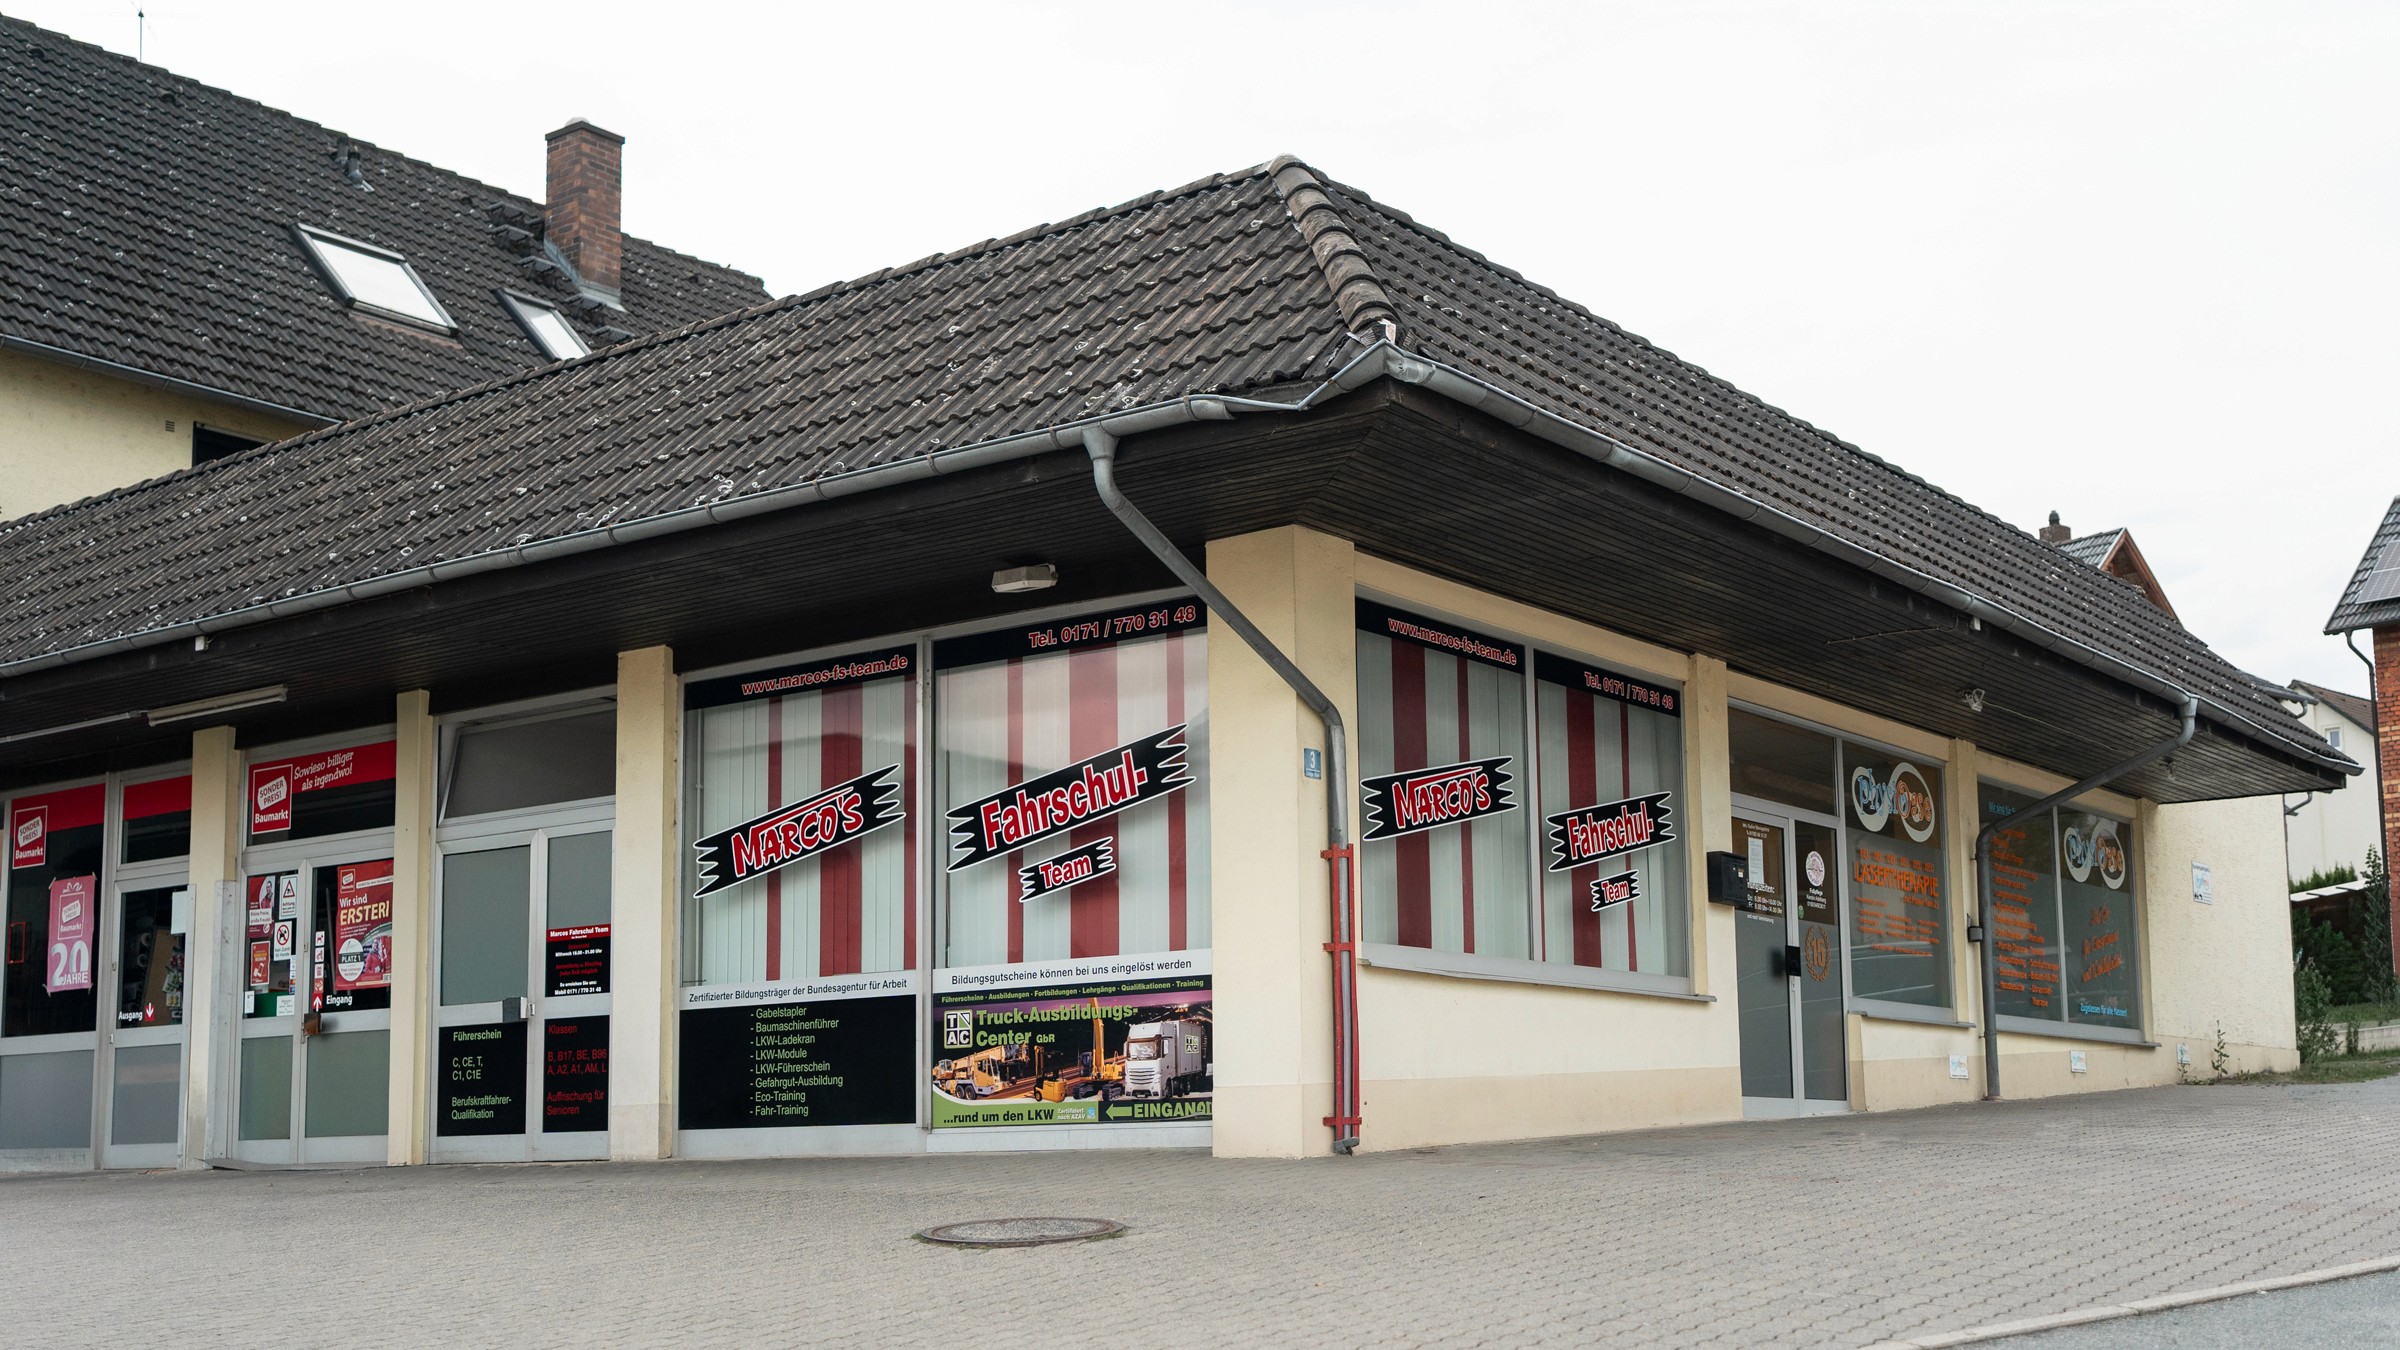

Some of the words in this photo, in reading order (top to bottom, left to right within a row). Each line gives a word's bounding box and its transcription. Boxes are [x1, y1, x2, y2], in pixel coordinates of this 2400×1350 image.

[1029, 630, 1057, 648] Tel.
[1061, 622, 1099, 642] 0171
[1104, 620, 1111, 637] /
[1114, 615, 1145, 633] 770
[1149, 609, 1168, 628] 31
[1174, 605, 1196, 623] 48
[1387, 617, 1517, 666] www.marcos-fs-team.de
[741, 654, 908, 695] www.marcos-fs-team.de
[1584, 671, 1601, 690] Tel.
[1603, 677, 1624, 696] 0171
[1626, 684, 1630, 699] /
[1632, 685, 1648, 703] 770
[1650, 691, 1660, 706] 31
[1662, 695, 1673, 709] 48
[294, 763, 325, 780] Sowieso
[327, 752, 354, 768] billiger
[1310, 751, 1316, 769] 3
[301, 778, 313, 791] als
[314, 763, 352, 789] irgendwo!
[260, 780, 284, 798] SONDER
[263, 791, 282, 806] PREIS!
[980, 749, 1148, 851] Fahrschul-
[255, 809, 288, 824] Baumarkt
[20, 820, 40, 836] SONDER
[1567, 801, 1655, 859] Fahrschul-
[23, 830, 38, 842] PREIS!
[16, 846, 43, 859] Baumarkt
[1039, 854, 1091, 889] Team
[1855, 860, 1939, 897] LASERTHERAPIE
[1602, 879, 1630, 904] Team
[340, 898, 352, 908] Wir
[352, 893, 368, 906] sind
[60, 923, 81, 932] Baumarkt
[569, 927, 594, 936] Fahrschul
[342, 955, 358, 963] PLATZ
[1810, 938, 1824, 966] 15
[51, 940, 89, 987] 20
[62, 972, 88, 985] JAHRE
[952, 972, 1037, 985] Bildungsgutscheine
[1040, 969, 1073, 978] können
[1075, 966, 1089, 976] bei
[1092, 965, 1109, 974] uns
[1112, 961, 1154, 974] eingelöst
[1156, 959, 1192, 970] werden
[689, 993, 733, 1002] Zertifizierter
[735, 988, 790, 1000] Bildungsträger
[793, 987, 805, 996] der
[808, 981, 867, 994] Bundesagentur
[869, 981, 880, 990] für
[882, 979, 907, 989] Arbeit
[942, 995, 984, 1003] Führerscheine
[988, 992, 1029, 1000] Ausbildungen
[1034, 988, 1077, 997] Fortbildungen
[1082, 986, 1116, 994] Lehrgänge
[1121, 982, 1171, 991] Qualifikationen
[1176, 980, 1204, 988] Training
[326, 994, 352, 1006] Eingang
[118, 1010, 143, 1022] Ausgang
[756, 1006, 807, 1019] Gabelstapler
[976, 1004, 1138, 1025] Truck-Ausbildungs-
[548, 1024, 577, 1035] Klassen
[756, 1018, 839, 1032] Baumaschinenführer
[453, 1029, 502, 1041] Führerschein
[756, 1034, 815, 1046] LKW-Ladekran
[976, 1030, 1032, 1046] Center
[1036, 1034, 1055, 1043] GbR
[548, 1051, 555, 1062] B,
[557, 1050, 575, 1061] B17,
[577, 1049, 590, 1061] BE,
[592, 1049, 607, 1059] B96
[756, 1048, 807, 1060] LKW-Module
[453, 1057, 461, 1069] C,
[462, 1057, 475, 1069] CE,
[476, 1056, 483, 1068] T,
[547, 1065, 555, 1076] A,
[557, 1064, 569, 1075] A2,
[571, 1064, 583, 1075] A1,
[584, 1063, 600, 1074] AM,
[601, 1063, 606, 1073] L
[756, 1062, 831, 1074] LKW-Führerschein
[452, 1070, 464, 1081] C1,
[466, 1069, 482, 1080] C1E
[755, 1075, 843, 1089] Gefahrgut-Ausbildung
[452, 1095, 512, 1107] Berufskraftfahrer-
[547, 1091, 592, 1103] Auffrischung
[594, 1090, 604, 1101] für
[755, 1091, 806, 1103] Eco-Training
[451, 1108, 494, 1120] Qualifikation
[546, 1105, 579, 1116] Senioren
[755, 1105, 809, 1116] Fahr-Training
[943, 1112, 978, 1123] ...rund
[982, 1114, 996, 1122] um
[1003, 1111, 1023, 1121] den
[1028, 1109, 1054, 1120] LKW
